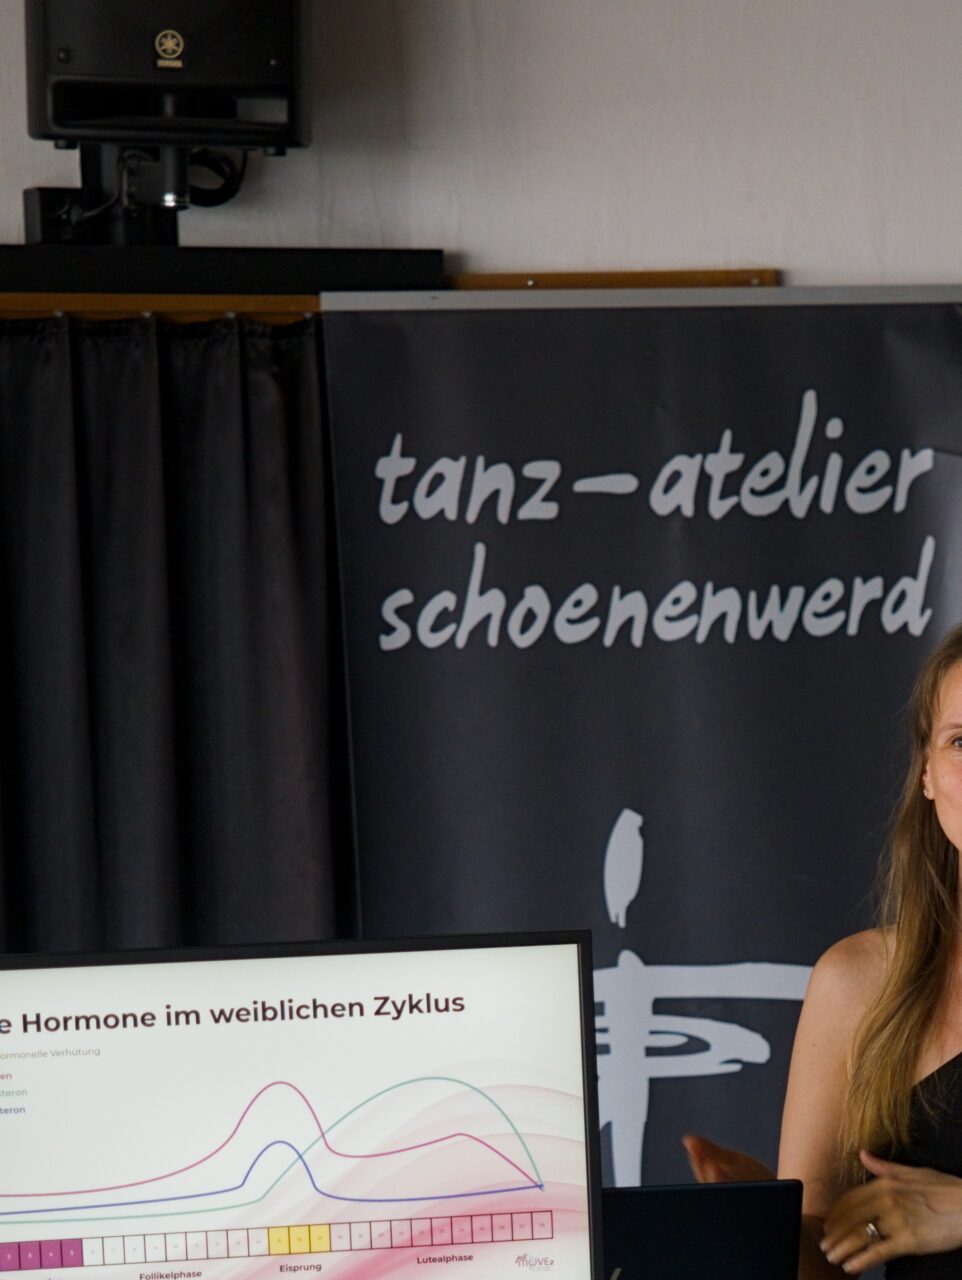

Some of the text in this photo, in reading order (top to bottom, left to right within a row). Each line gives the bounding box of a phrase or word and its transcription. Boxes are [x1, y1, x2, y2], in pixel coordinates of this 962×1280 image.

[374, 389, 934, 524] tanz-atelier
[379, 535, 936, 651] schoenenwerd
[22, 1009, 156, 1033] Hormone
[165, 1004, 201, 1026] im
[210, 998, 365, 1024] weiblichen
[374, 993, 466, 1020] Zyklus
[0, 1088, 28, 1097] teron
[416, 1253, 474, 1265] Lutealphase
[279, 1262, 322, 1274] Eisprung
[139, 1269, 203, 1280] Follikelphase
